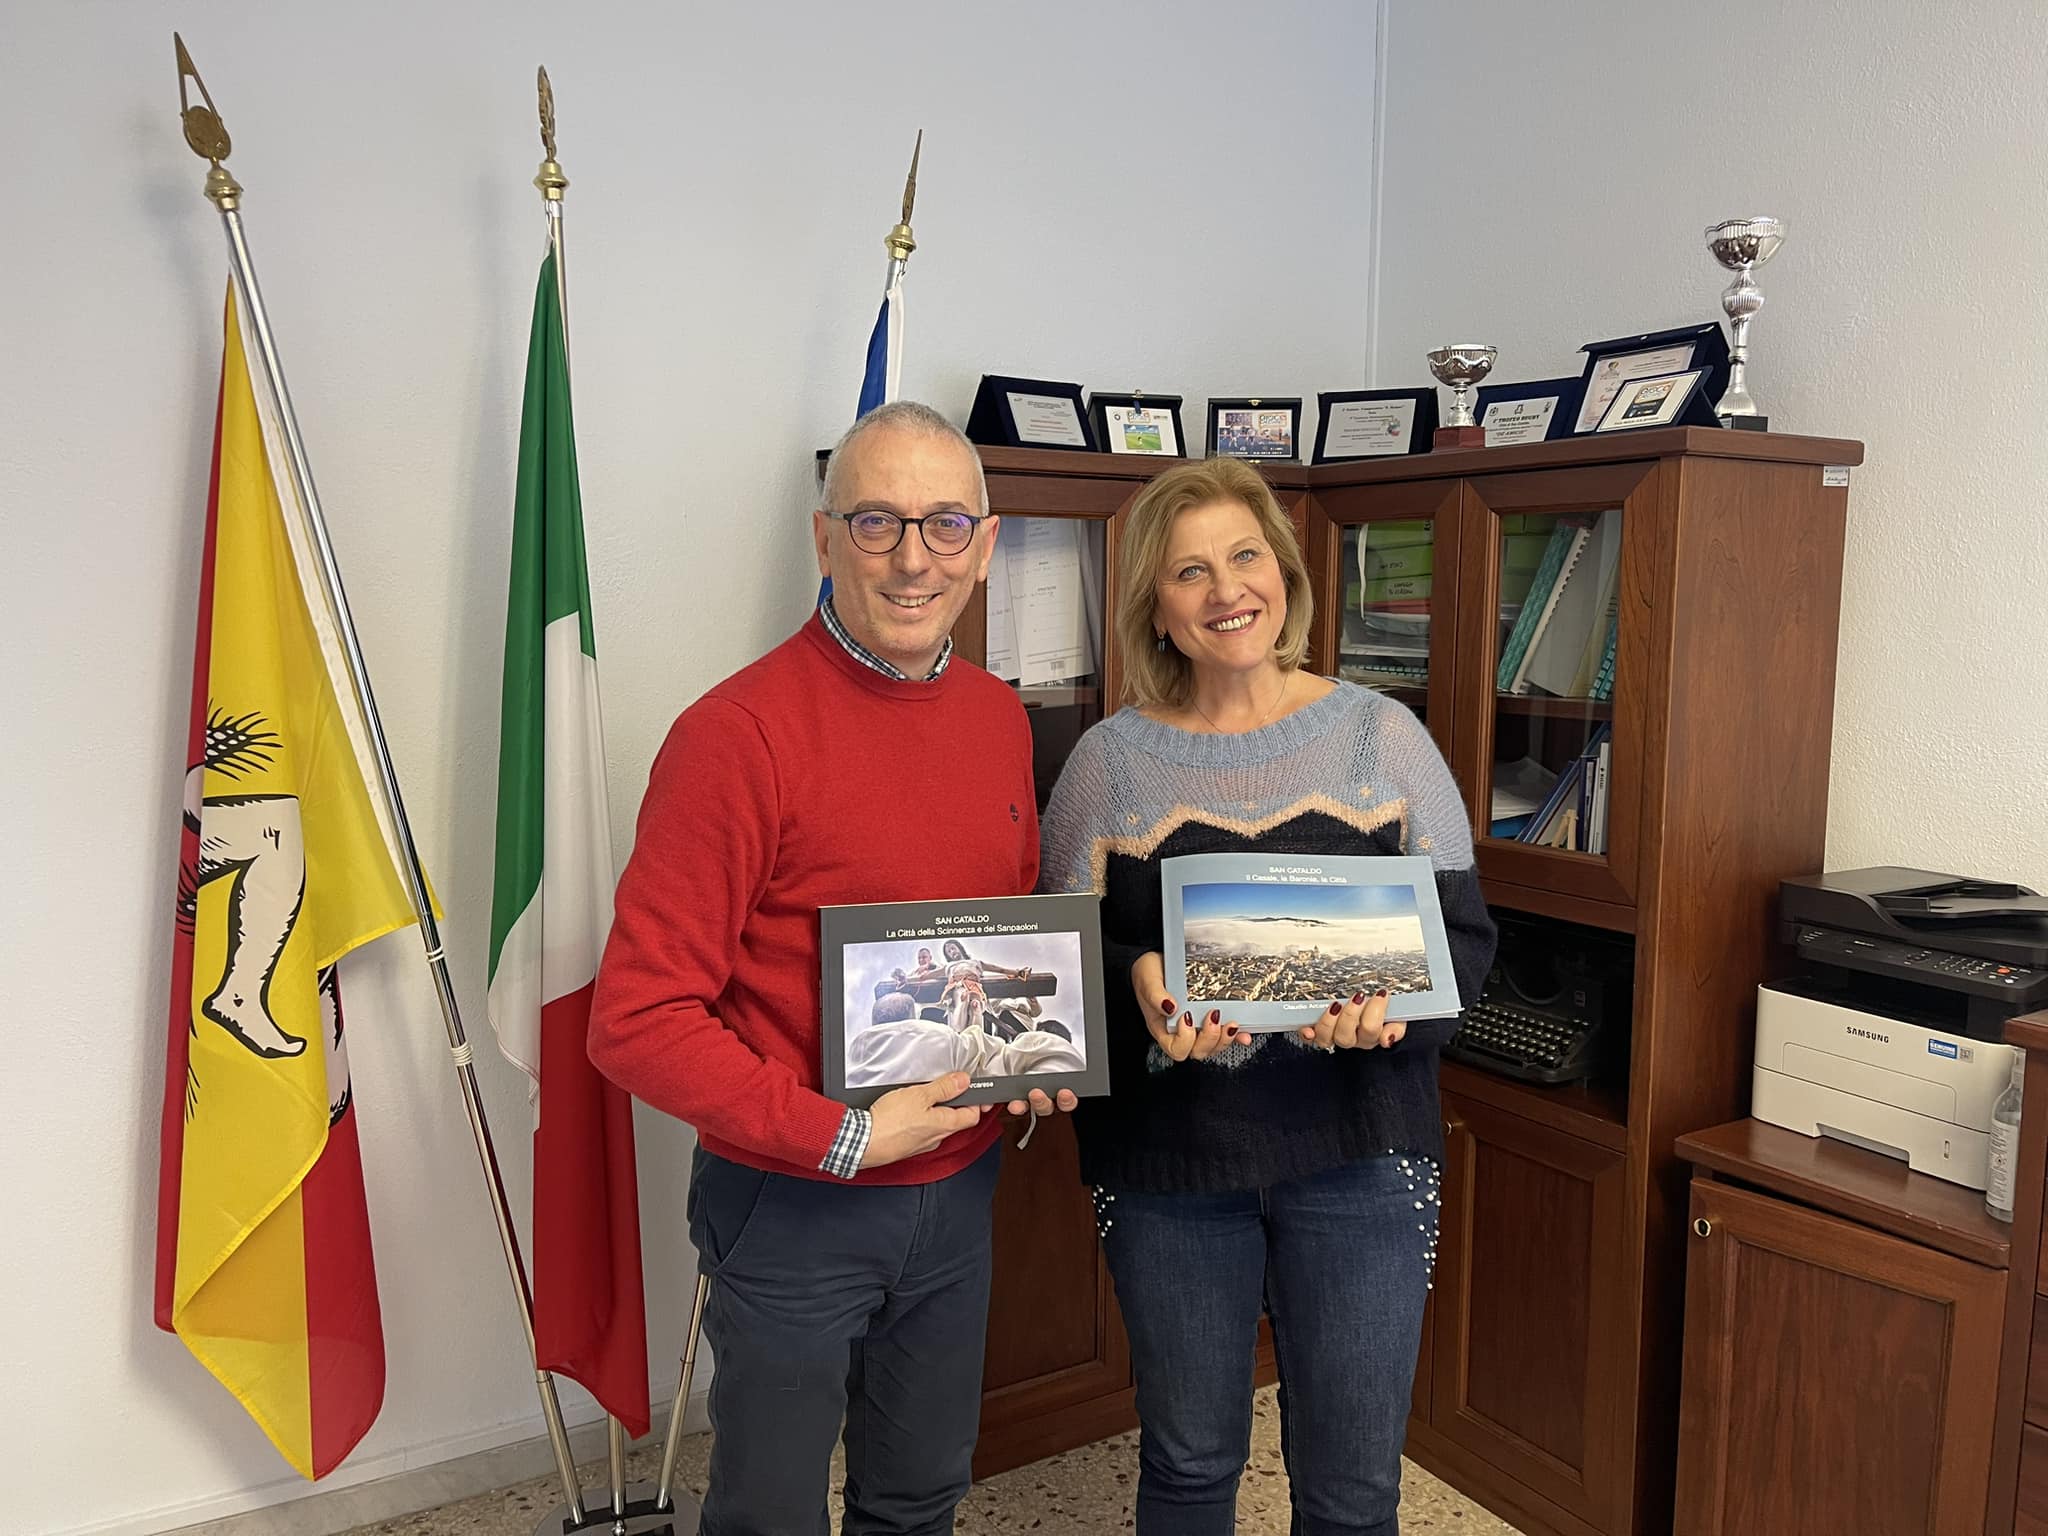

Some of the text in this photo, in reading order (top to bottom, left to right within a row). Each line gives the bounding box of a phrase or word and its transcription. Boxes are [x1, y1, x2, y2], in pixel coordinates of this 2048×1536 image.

[935, 914, 990, 925] SAN CATALDO
[886, 929, 896, 938] La
[897, 928, 916, 937] Città
[917, 927, 935, 936] della
[936, 926, 975, 935] Scinnenza
[996, 922, 1038, 933] Sanpaoloni
[1846, 1026, 1889, 1043] SAMSUNG
